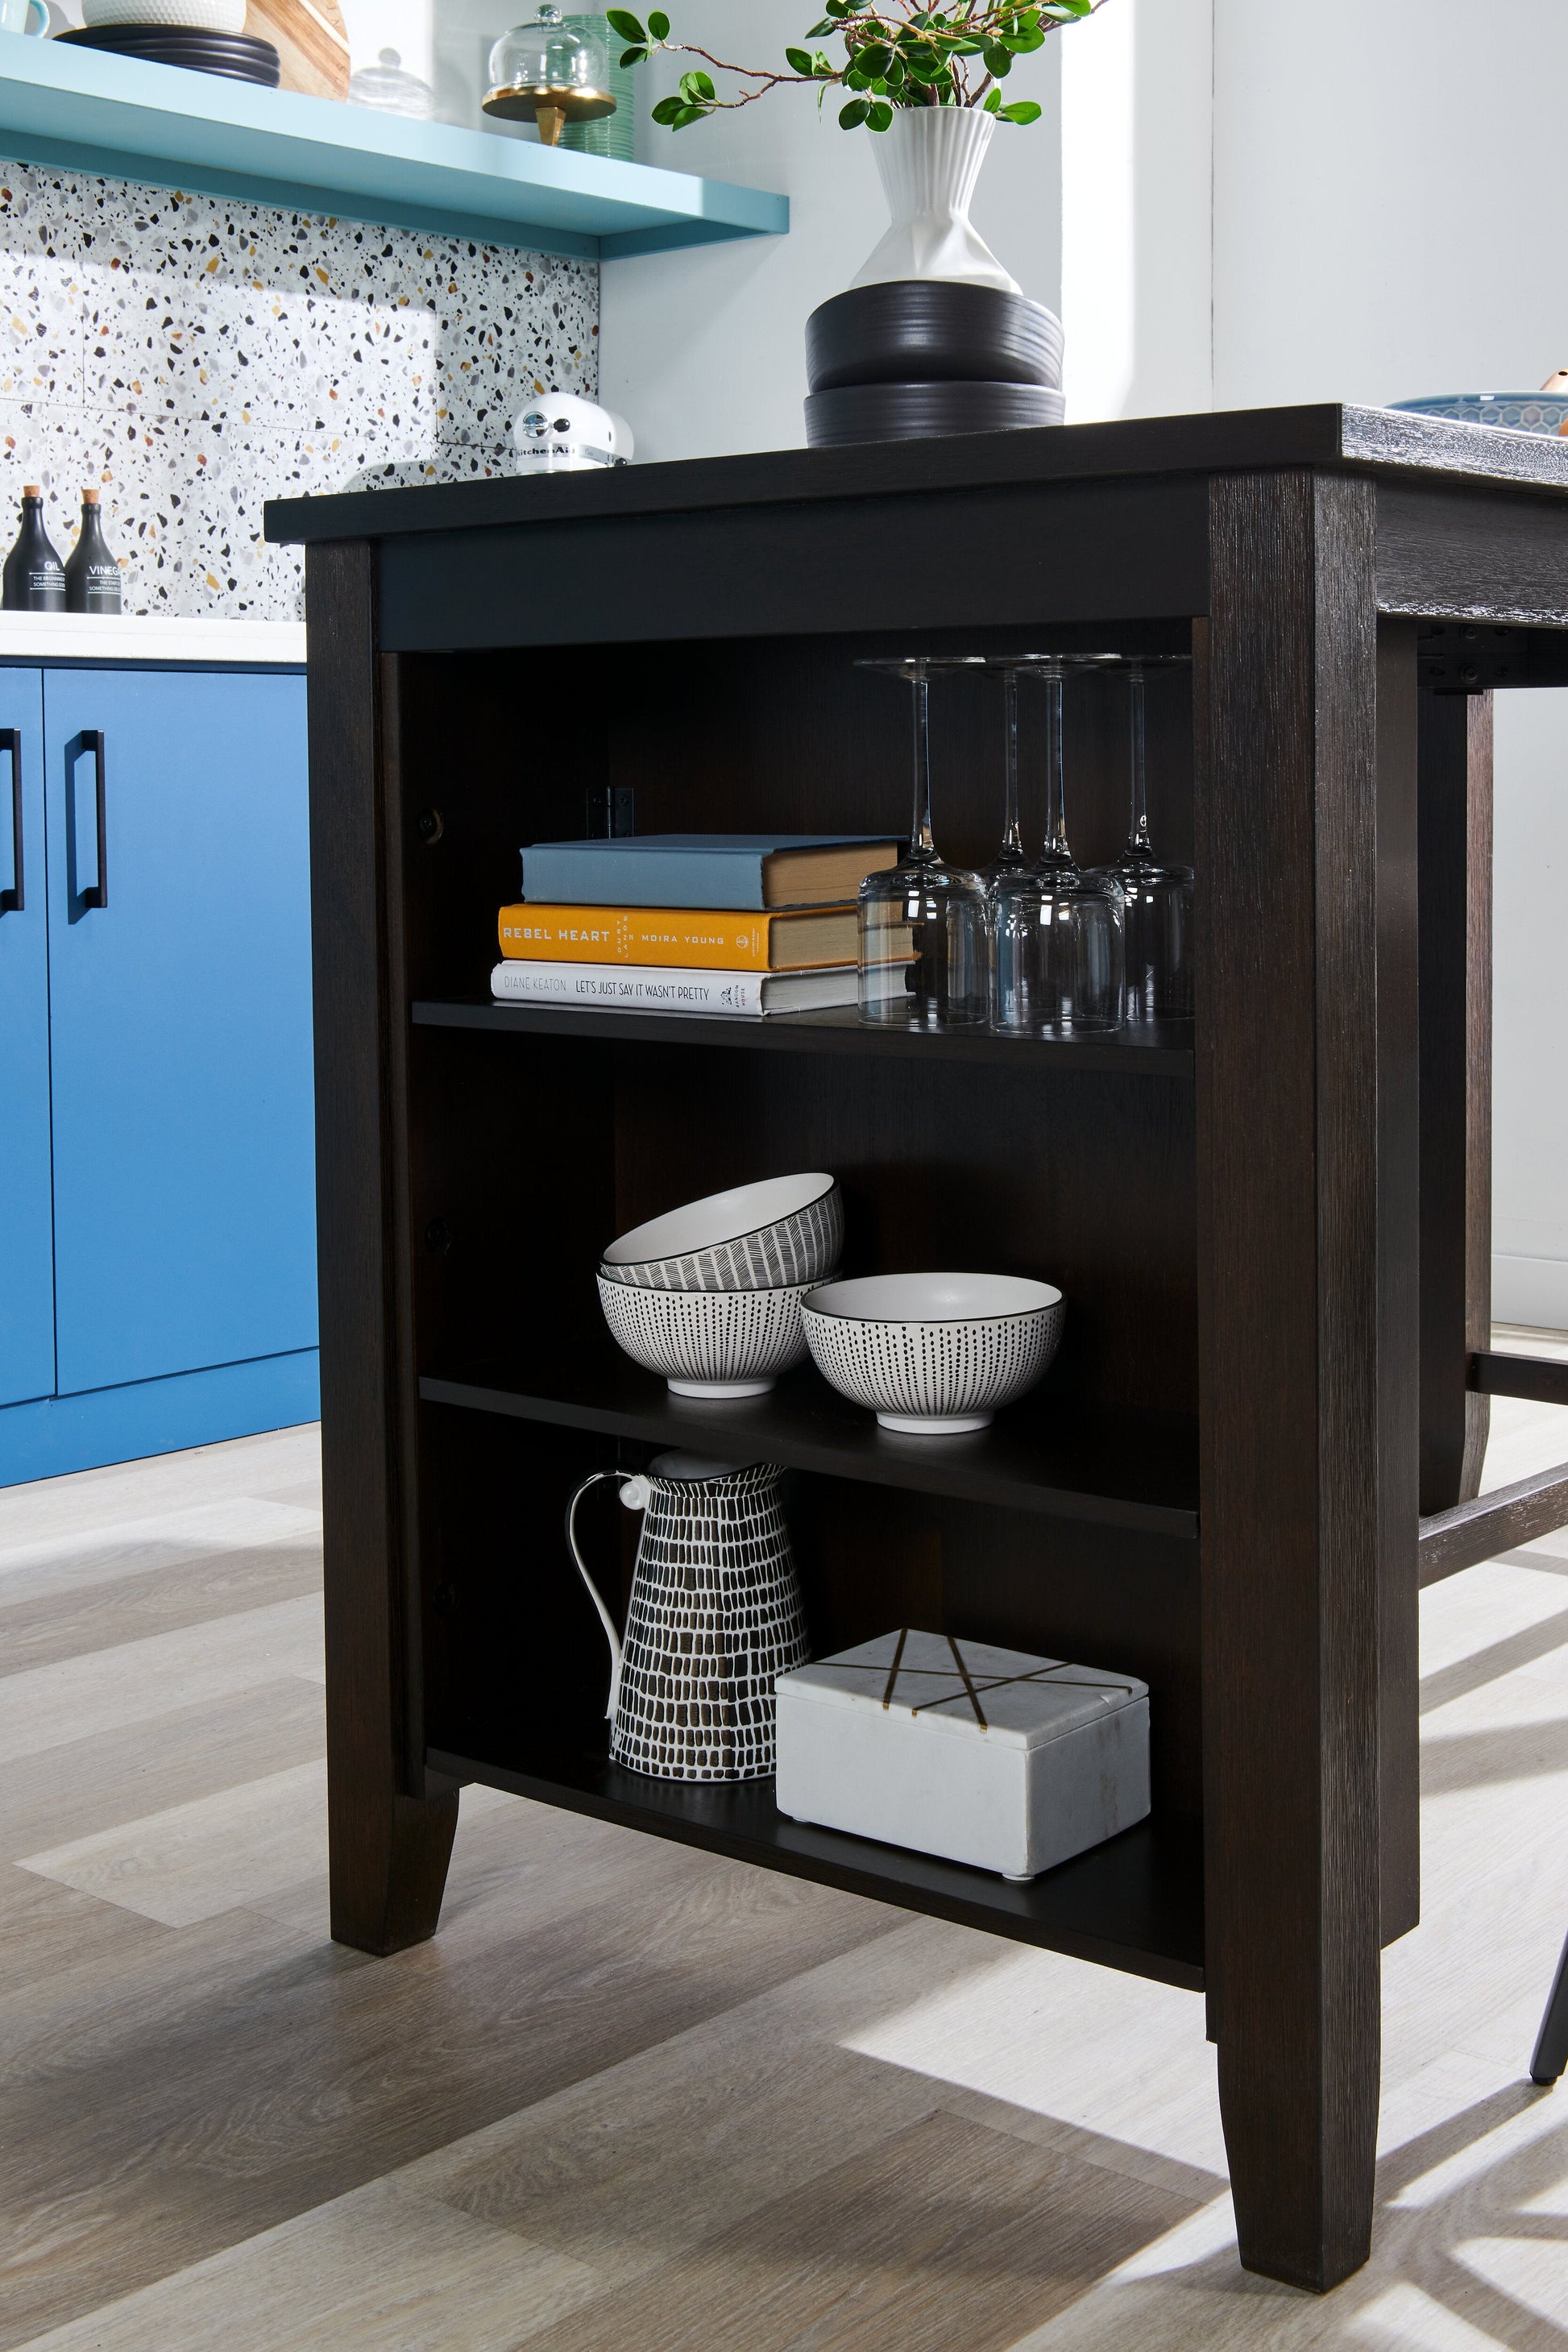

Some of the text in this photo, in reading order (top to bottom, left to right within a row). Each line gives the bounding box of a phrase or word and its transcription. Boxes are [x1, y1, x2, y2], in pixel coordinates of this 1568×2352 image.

[44, 562, 60, 571] OIL
[503, 927, 610, 942] REBEL HEART
[641, 935, 724, 944] MOIRA YOUNG
[504, 976, 566, 992] DIANE KEATON
[575, 980, 710, 1001] LET'S JUST SAY IT WASN'T PRETTY
